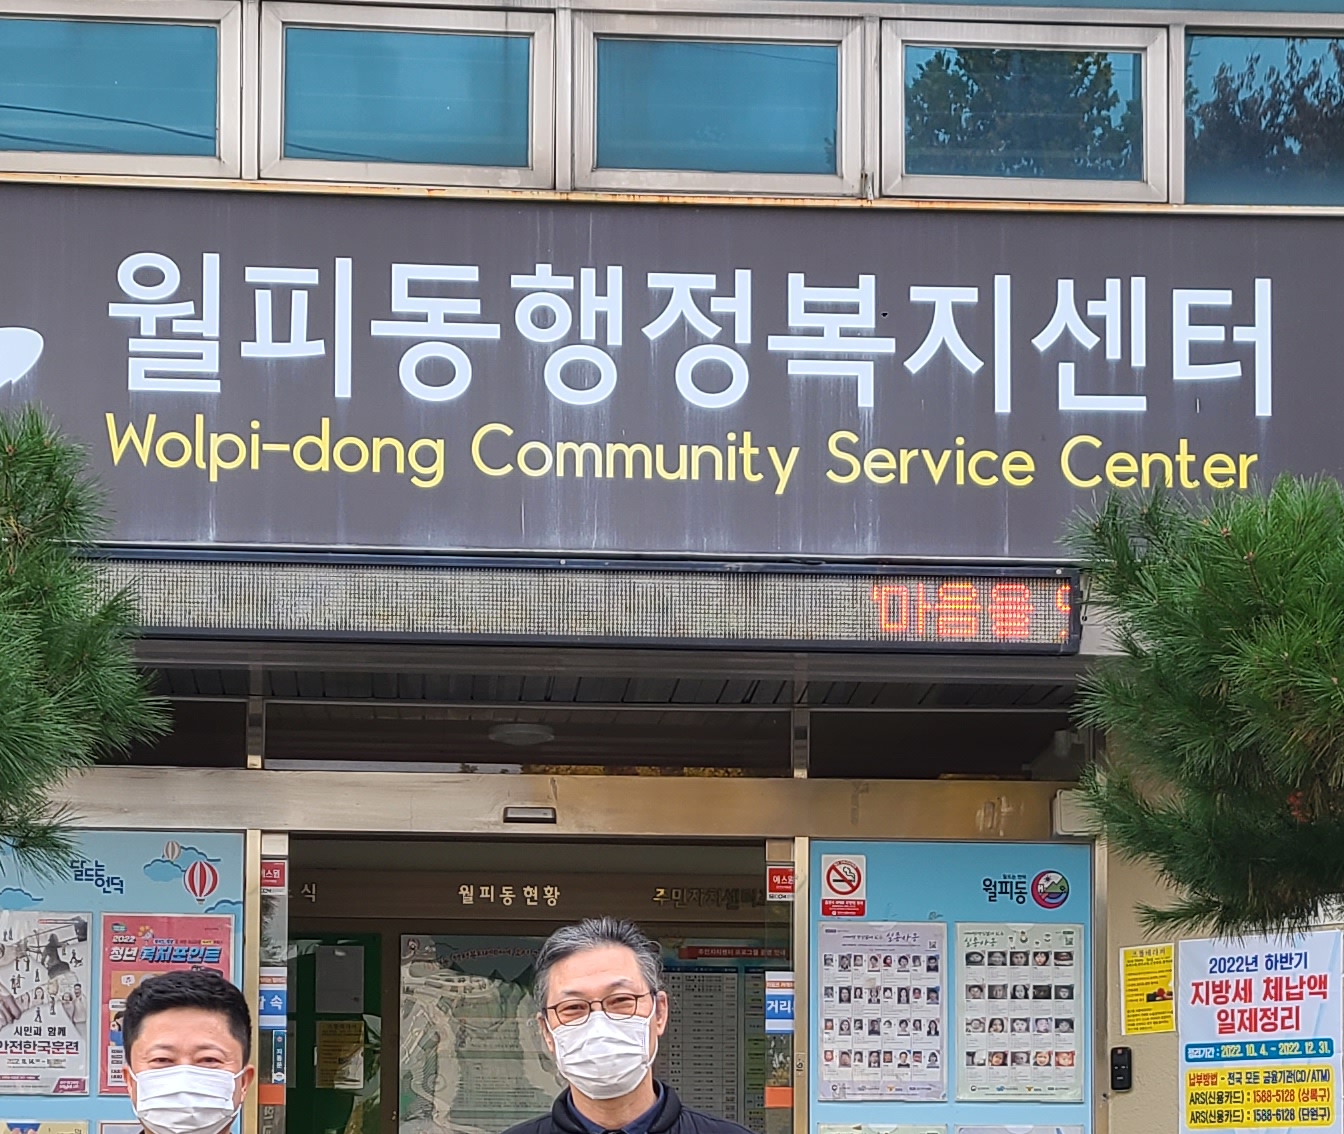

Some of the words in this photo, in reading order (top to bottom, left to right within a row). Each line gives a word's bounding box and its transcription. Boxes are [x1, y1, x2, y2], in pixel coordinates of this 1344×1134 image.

[108, 251, 1273, 417] 월피동행정복지센터
[104, 412, 445, 489] Wolpi-dong
[471, 422, 801, 495] Community
[826, 429, 1036, 487] Service
[1060, 433, 1259, 490] Center
[260, 869, 281, 879] 스원
[458, 885, 517, 906] 월피동
[523, 885, 561, 907] 현황
[982, 878, 1028, 905] 월피동
[109, 946, 139, 962] 청년
[1208, 954, 1258, 974] 2022년
[1264, 951, 1308, 971] 하반기
[1190, 978, 1253, 1006] 지방세
[1262, 973, 1328, 1002] 체납액
[766, 999, 794, 1014] 거리
[1216, 1005, 1300, 1035] 일제정리
[13, 1025, 42, 1037] 시민과
[47, 1026, 67, 1037] 함께
[1245, 1071, 1260, 1084] 모든
[1253, 1089, 1295, 1103] 1588-5128
[1253, 1108, 1295, 1122] 1588-6128
